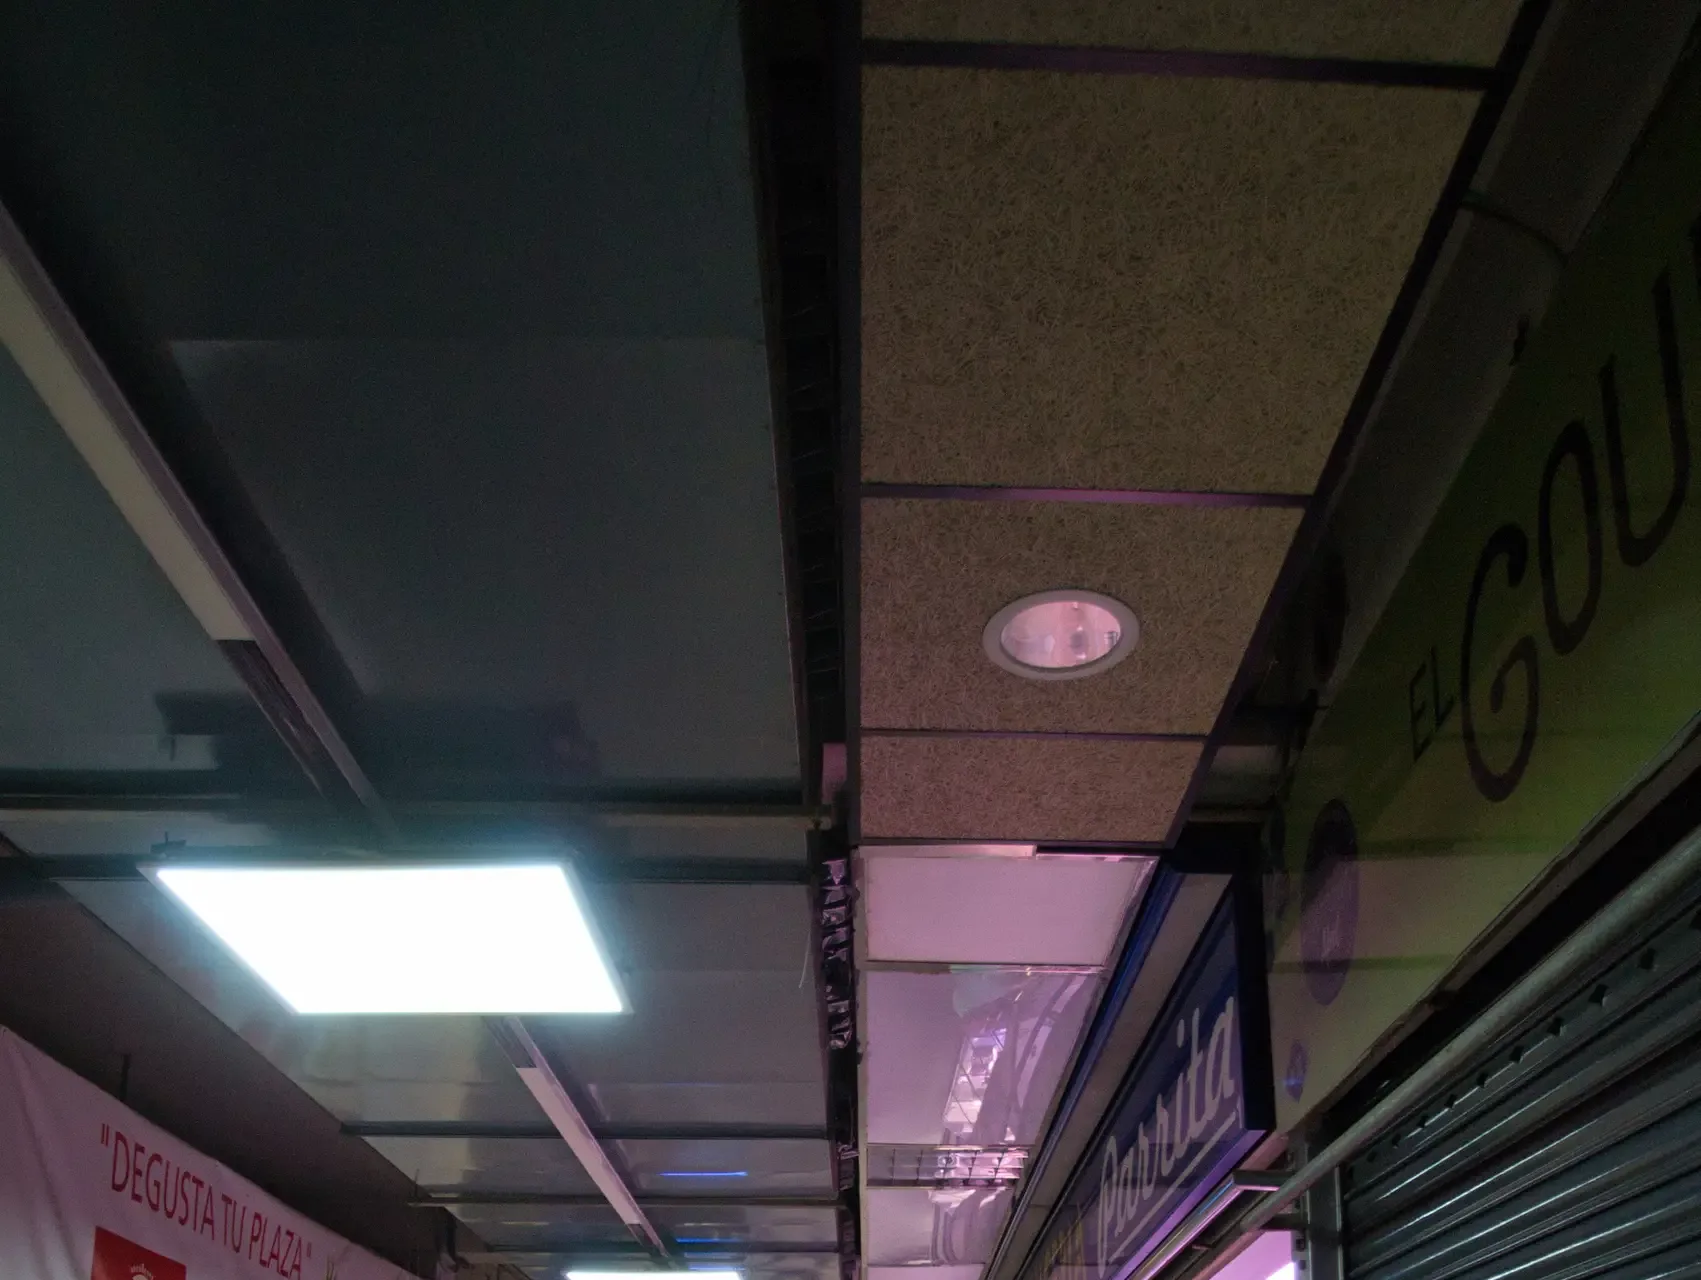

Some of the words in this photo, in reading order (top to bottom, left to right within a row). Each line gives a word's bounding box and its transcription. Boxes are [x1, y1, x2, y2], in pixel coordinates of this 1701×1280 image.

[1408, 644, 1455, 763] EL
[1459, 212, 1701, 804] GOU
[101, 1123, 215, 1241] "DEGUSTA
[221, 1193, 248, 1254] TU
